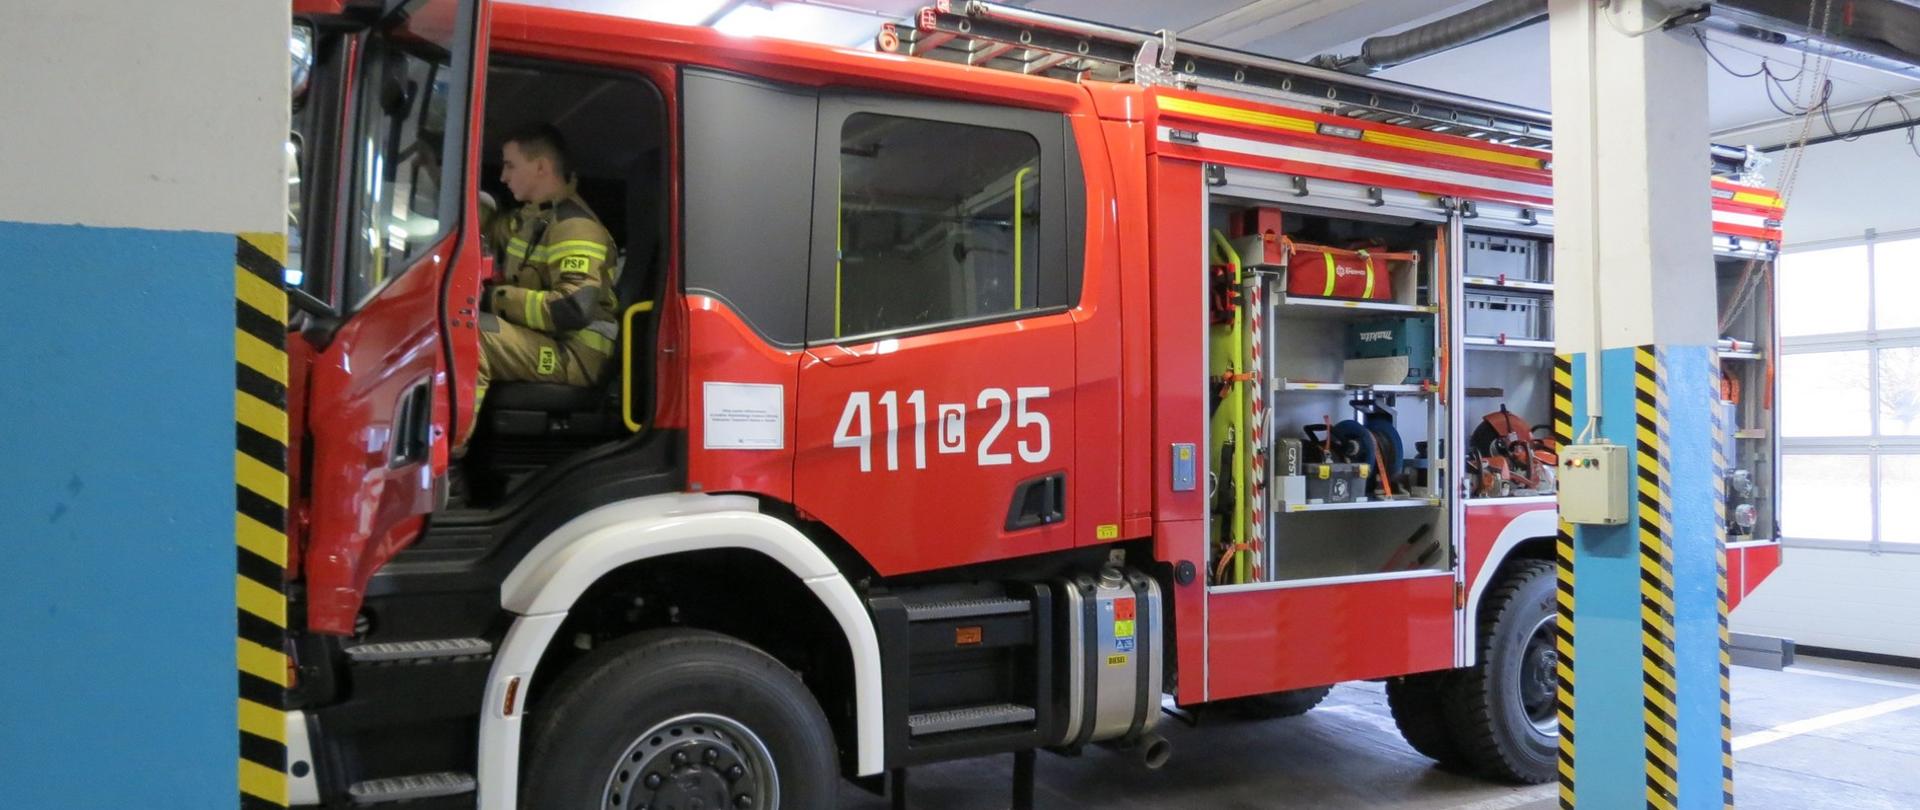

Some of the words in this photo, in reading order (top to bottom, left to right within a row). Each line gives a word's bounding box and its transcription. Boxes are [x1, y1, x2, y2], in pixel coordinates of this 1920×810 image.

[563, 259, 585, 269] PSP
[1360, 330, 1393, 342] makita
[542, 351, 552, 371] PSP
[833, 389, 927, 473] 411
[941, 406, 963, 450] C
[976, 386, 1051, 466] 25
